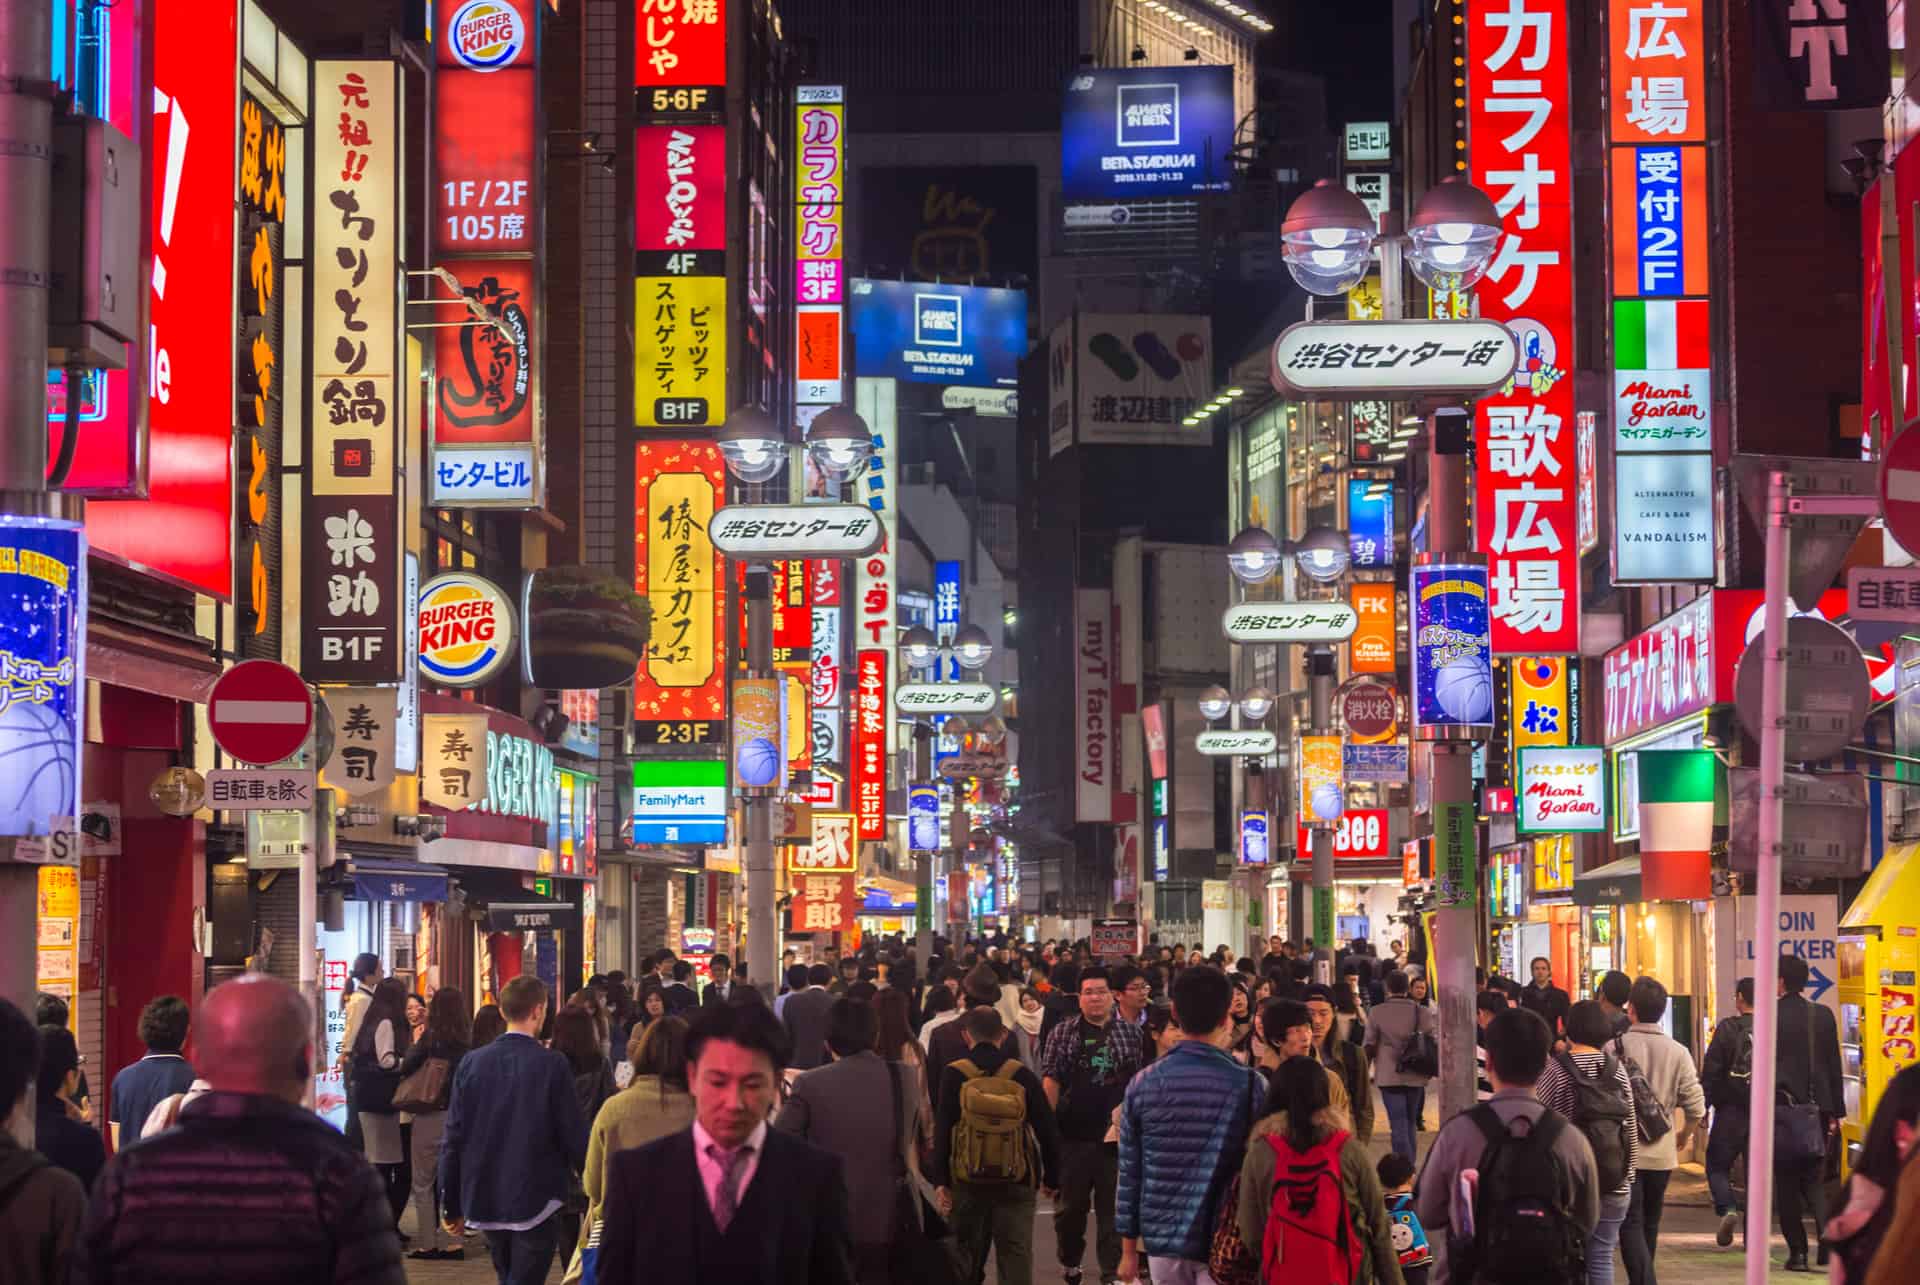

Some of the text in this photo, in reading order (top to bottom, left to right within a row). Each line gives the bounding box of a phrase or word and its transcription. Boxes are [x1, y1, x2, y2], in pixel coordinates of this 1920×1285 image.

[460, 12, 511, 38] BURGER
[463, 23, 513, 54] KING
[1124, 103, 1173, 117] ALWAYS
[1127, 113, 1171, 127] IN BETA
[1101, 153, 1196, 171] BETA STADIUM
[1483, 0, 1560, 312] カラオケ
[801, 109, 841, 257] カラオケ
[665, 253, 698, 274] 4F
[803, 279, 838, 300] 3F
[654, 282, 677, 394] スパゲッティ
[1288, 338, 1505, 370] 渋谷センター街
[810, 385, 828, 397] 2F
[1619, 381, 1694, 399] Miami
[661, 402, 701, 420] B1F
[436, 460, 532, 489] センタービル
[1634, 490, 1695, 498] ALTERNATIVE
[718, 518, 872, 539] 渋谷センター街
[1487, 403, 1567, 635] 歌広場
[1624, 532, 1708, 543] VANDALISM
[419, 600, 495, 629] BURGER
[1359, 597, 1388, 613] FK
[1231, 612, 1351, 631] 渋谷センター街
[419, 617, 496, 654] KING
[322, 636, 384, 662] B1F
[1607, 600, 1711, 740] カラオケ歌広場
[1346, 700, 1393, 721] 消火栓
[1521, 700, 1560, 734] 松
[342, 703, 381, 784] 寿司
[439, 728, 473, 799] 寿司
[212, 779, 308, 801] 自転車を除く
[861, 782, 881, 794] 2F
[1524, 782, 1584, 798] Miami
[639, 794, 706, 811] FamilyMart
[861, 801, 881, 813] 3F
[861, 819, 881, 831] 4F
[1778, 911, 1816, 932] OIN
[1746, 939, 1837, 961] LCKER
